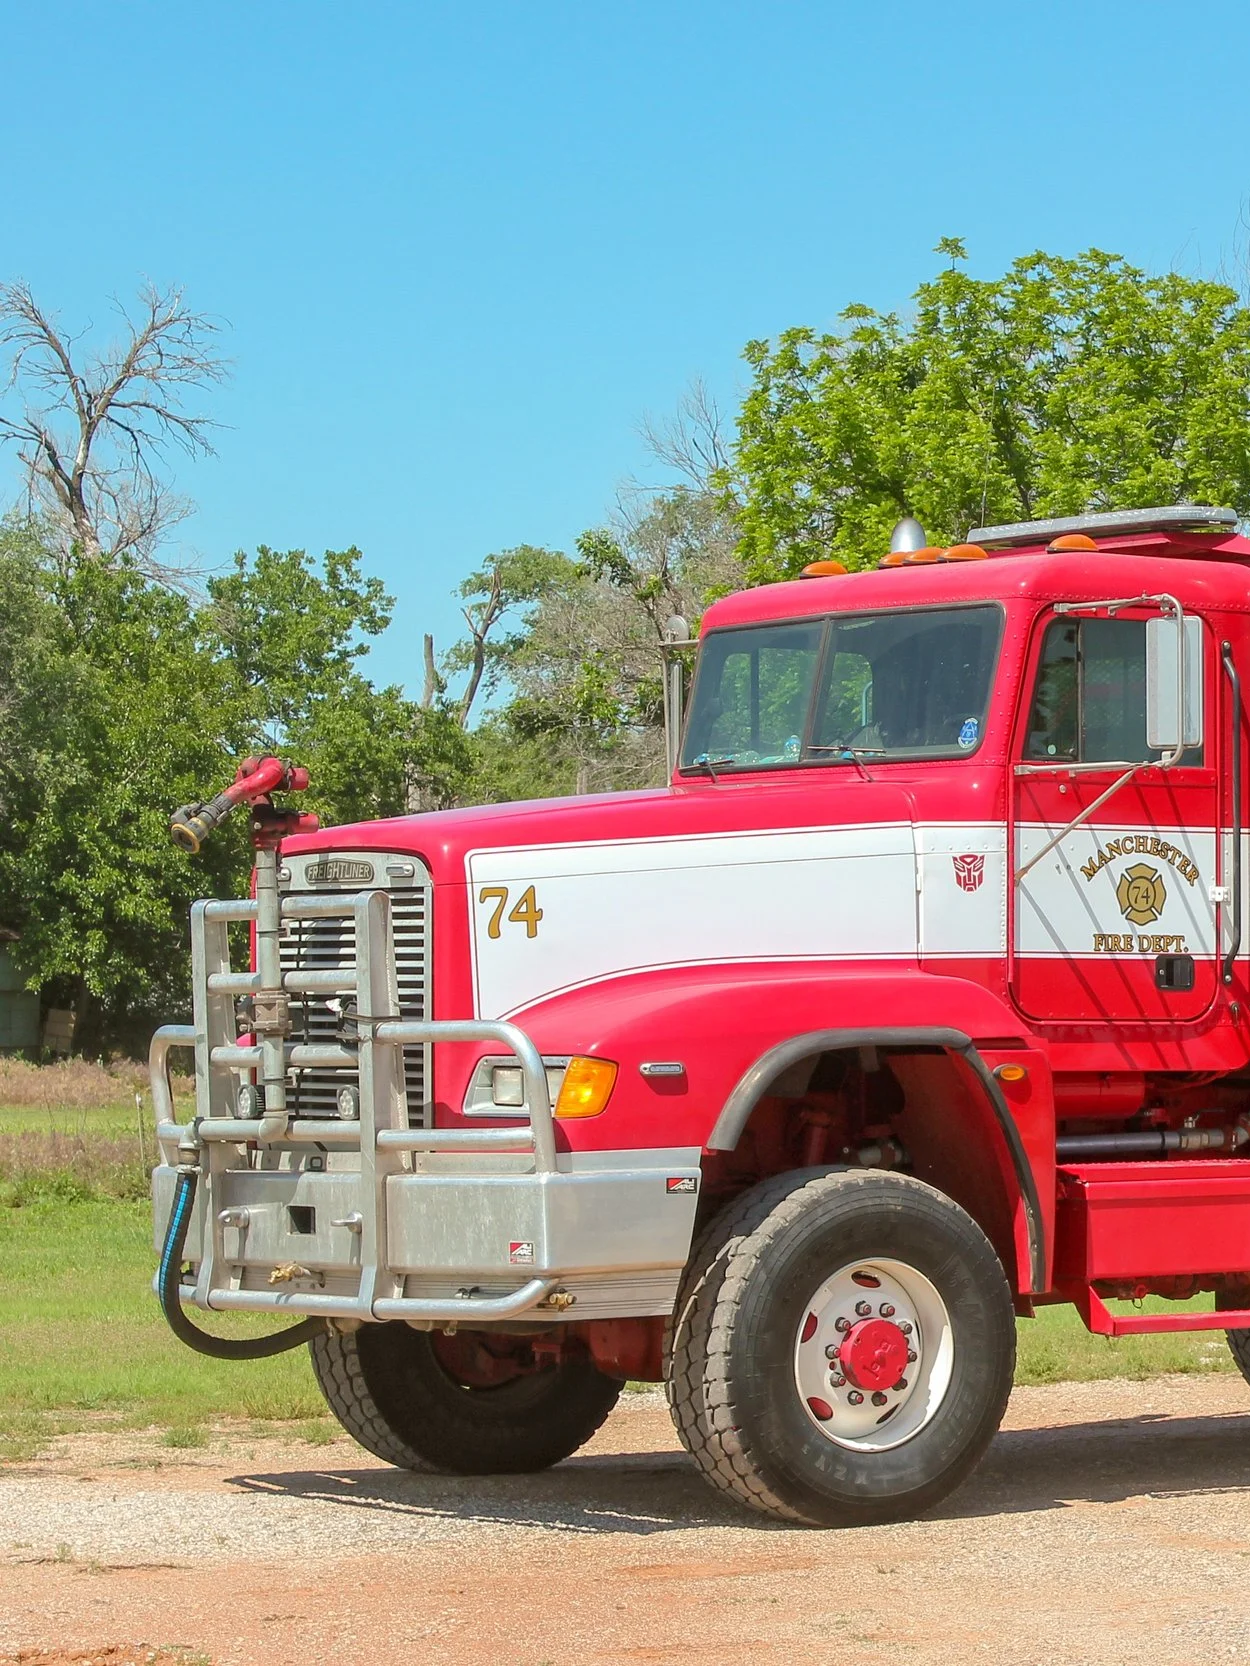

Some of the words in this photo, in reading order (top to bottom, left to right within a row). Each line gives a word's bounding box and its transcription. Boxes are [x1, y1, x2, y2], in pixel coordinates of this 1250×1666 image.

[1080, 834, 1200, 886] MANCHESTER
[307, 861, 370, 882] FREIGHTLINER
[1131, 886, 1151, 905] 74
[479, 884, 543, 939] 74
[1093, 933, 1134, 952] FIRE
[1137, 934, 1189, 953] DEPT.
